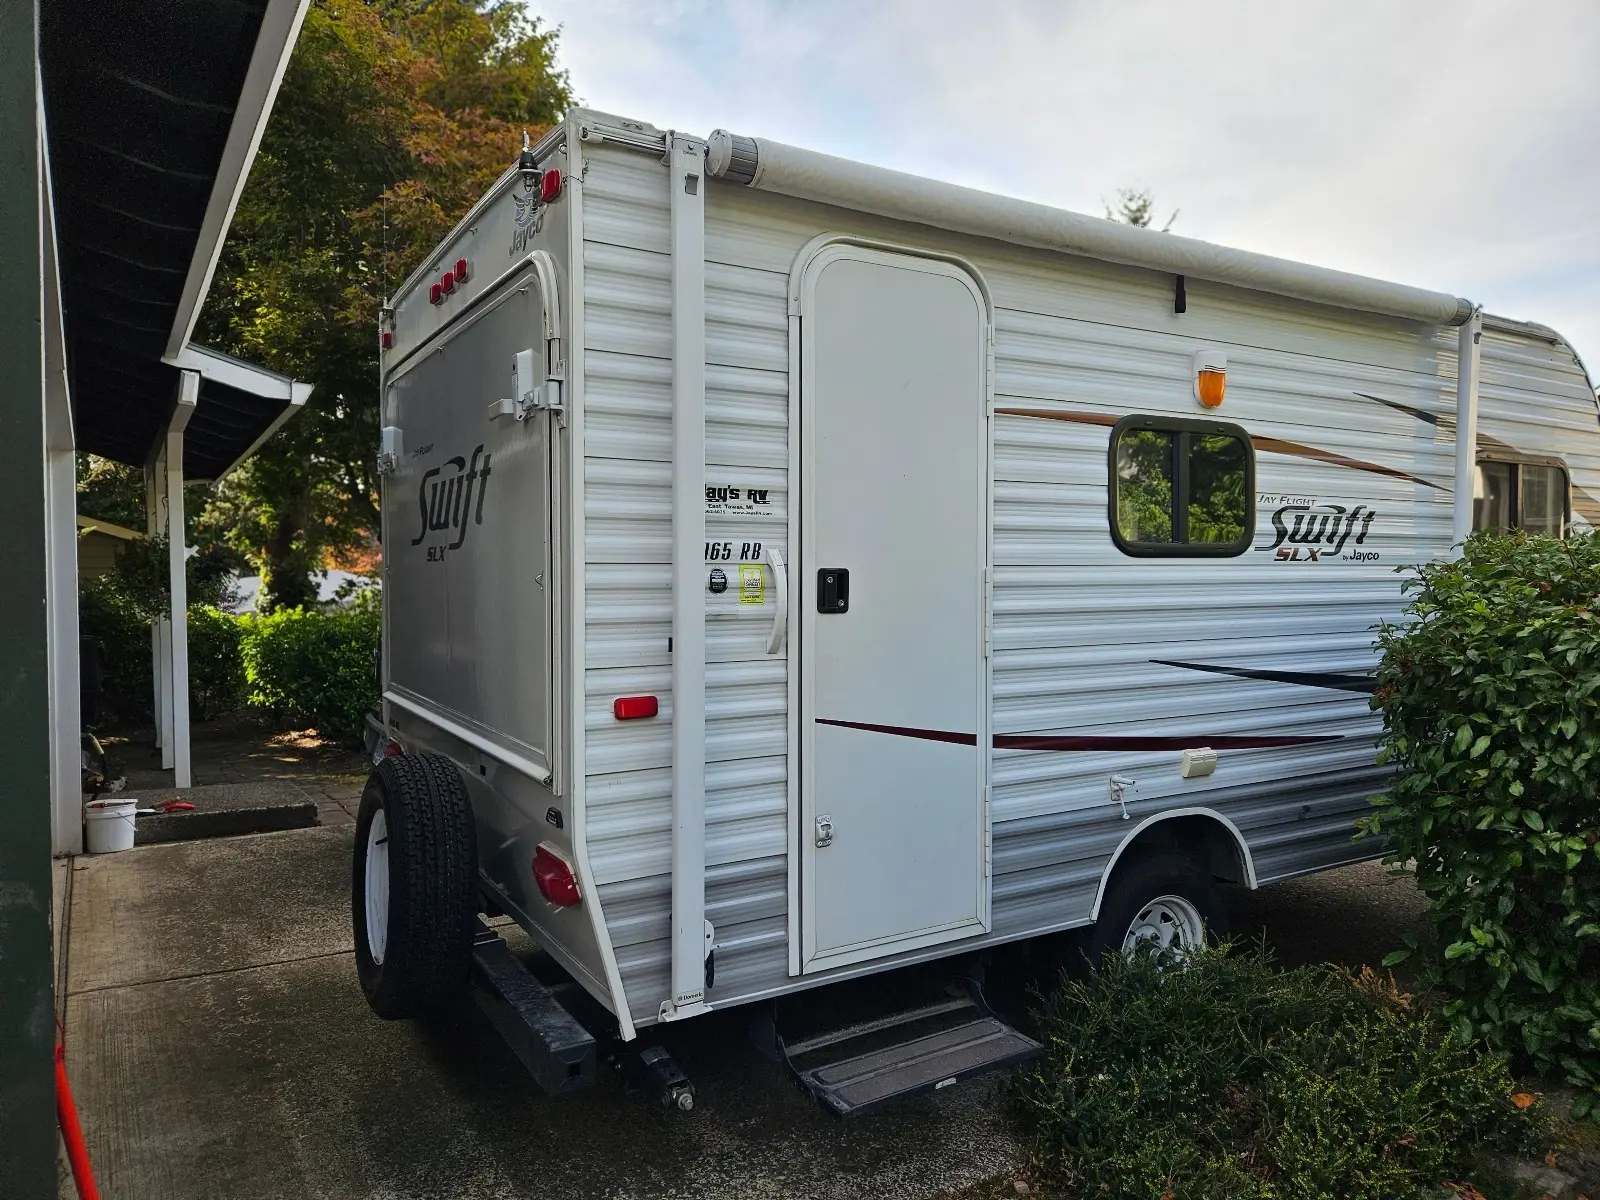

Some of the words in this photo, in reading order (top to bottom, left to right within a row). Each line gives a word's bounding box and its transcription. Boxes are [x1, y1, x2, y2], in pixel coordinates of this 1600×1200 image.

[508, 214, 544, 256] Jayco
[411, 443, 492, 551] Swift
[747, 489, 771, 504] RV
[1257, 494, 1277, 504] JAY
[1279, 495, 1318, 506] FLIGHT
[1253, 504, 1377, 557] Swift
[426, 545, 447, 562] SLX
[740, 541, 762, 561] RB
[1273, 547, 1323, 562] SLX
[1349, 549, 1380, 563] Jayco
